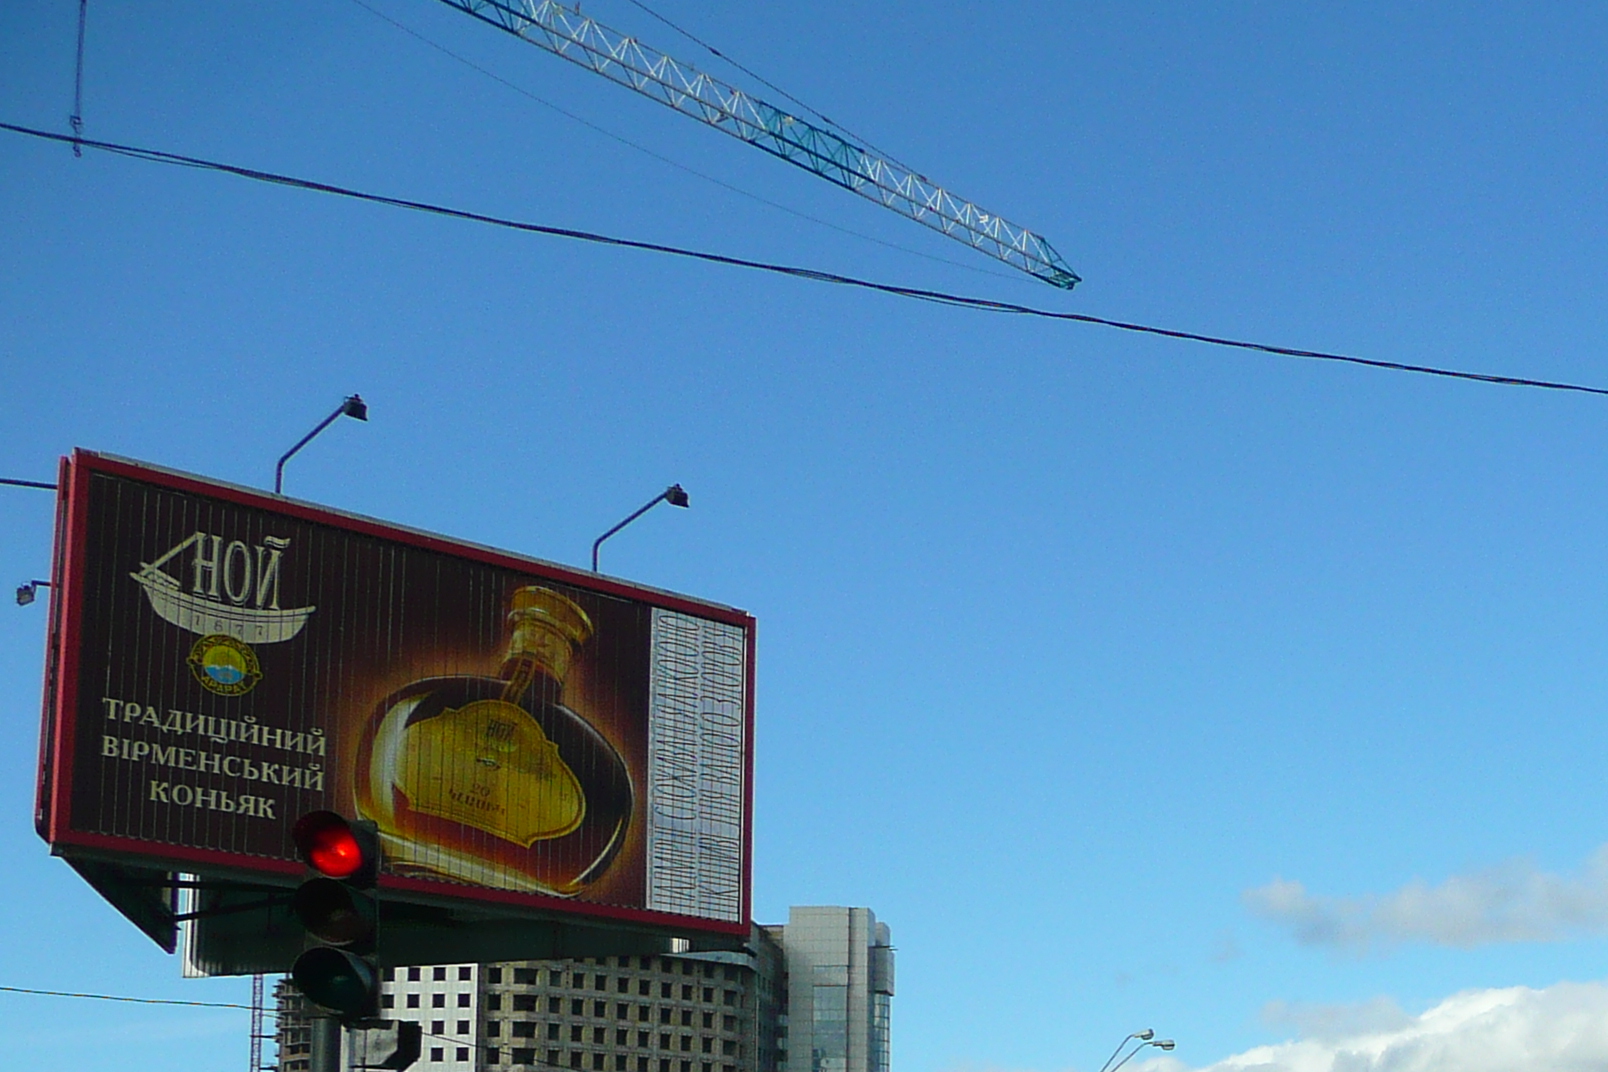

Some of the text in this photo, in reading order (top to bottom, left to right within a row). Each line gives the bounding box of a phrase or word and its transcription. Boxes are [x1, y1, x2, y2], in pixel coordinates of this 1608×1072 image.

[192, 532, 291, 611] НОЙ
[201, 676, 247, 694] АРАРАТ
[103, 697, 326, 757] ТРАДИЦІЙНИЙ
[700, 712, 740, 786] ВАШОГО
[102, 735, 324, 791] ВІРМЕНСЬКИЙ
[654, 615, 700, 909] НАДМІРНЕ СПОЖИВАННЯ АЛКОГОЛЮ
[150, 780, 276, 820] КОНЬЯК
[699, 789, 740, 827] ДЛЯ
